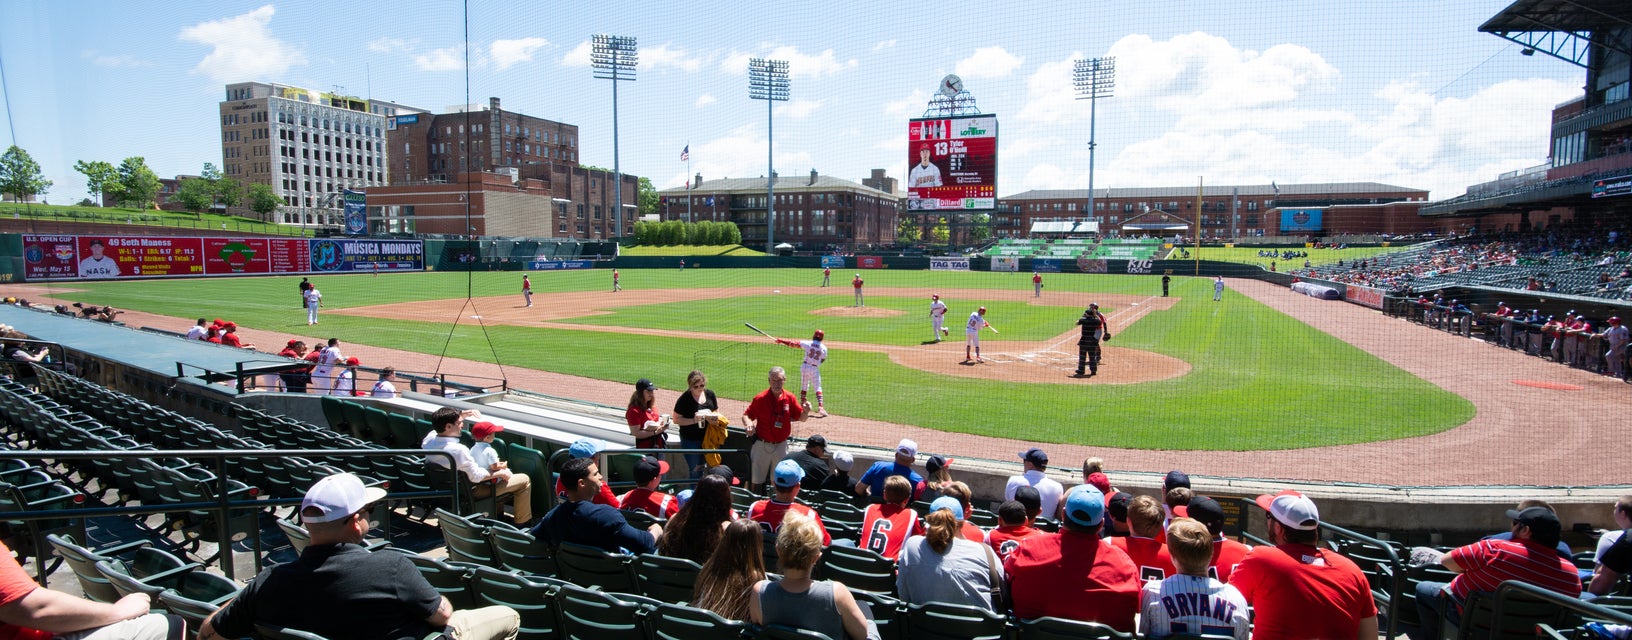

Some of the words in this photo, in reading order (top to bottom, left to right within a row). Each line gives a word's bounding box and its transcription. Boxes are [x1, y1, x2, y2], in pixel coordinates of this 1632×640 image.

[934, 142, 948, 156] 13
[345, 240, 379, 254] MÚSICA
[382, 243, 421, 254] MONDAYS
[868, 518, 892, 555] 6
[1162, 592, 1237, 624] BRYANT
